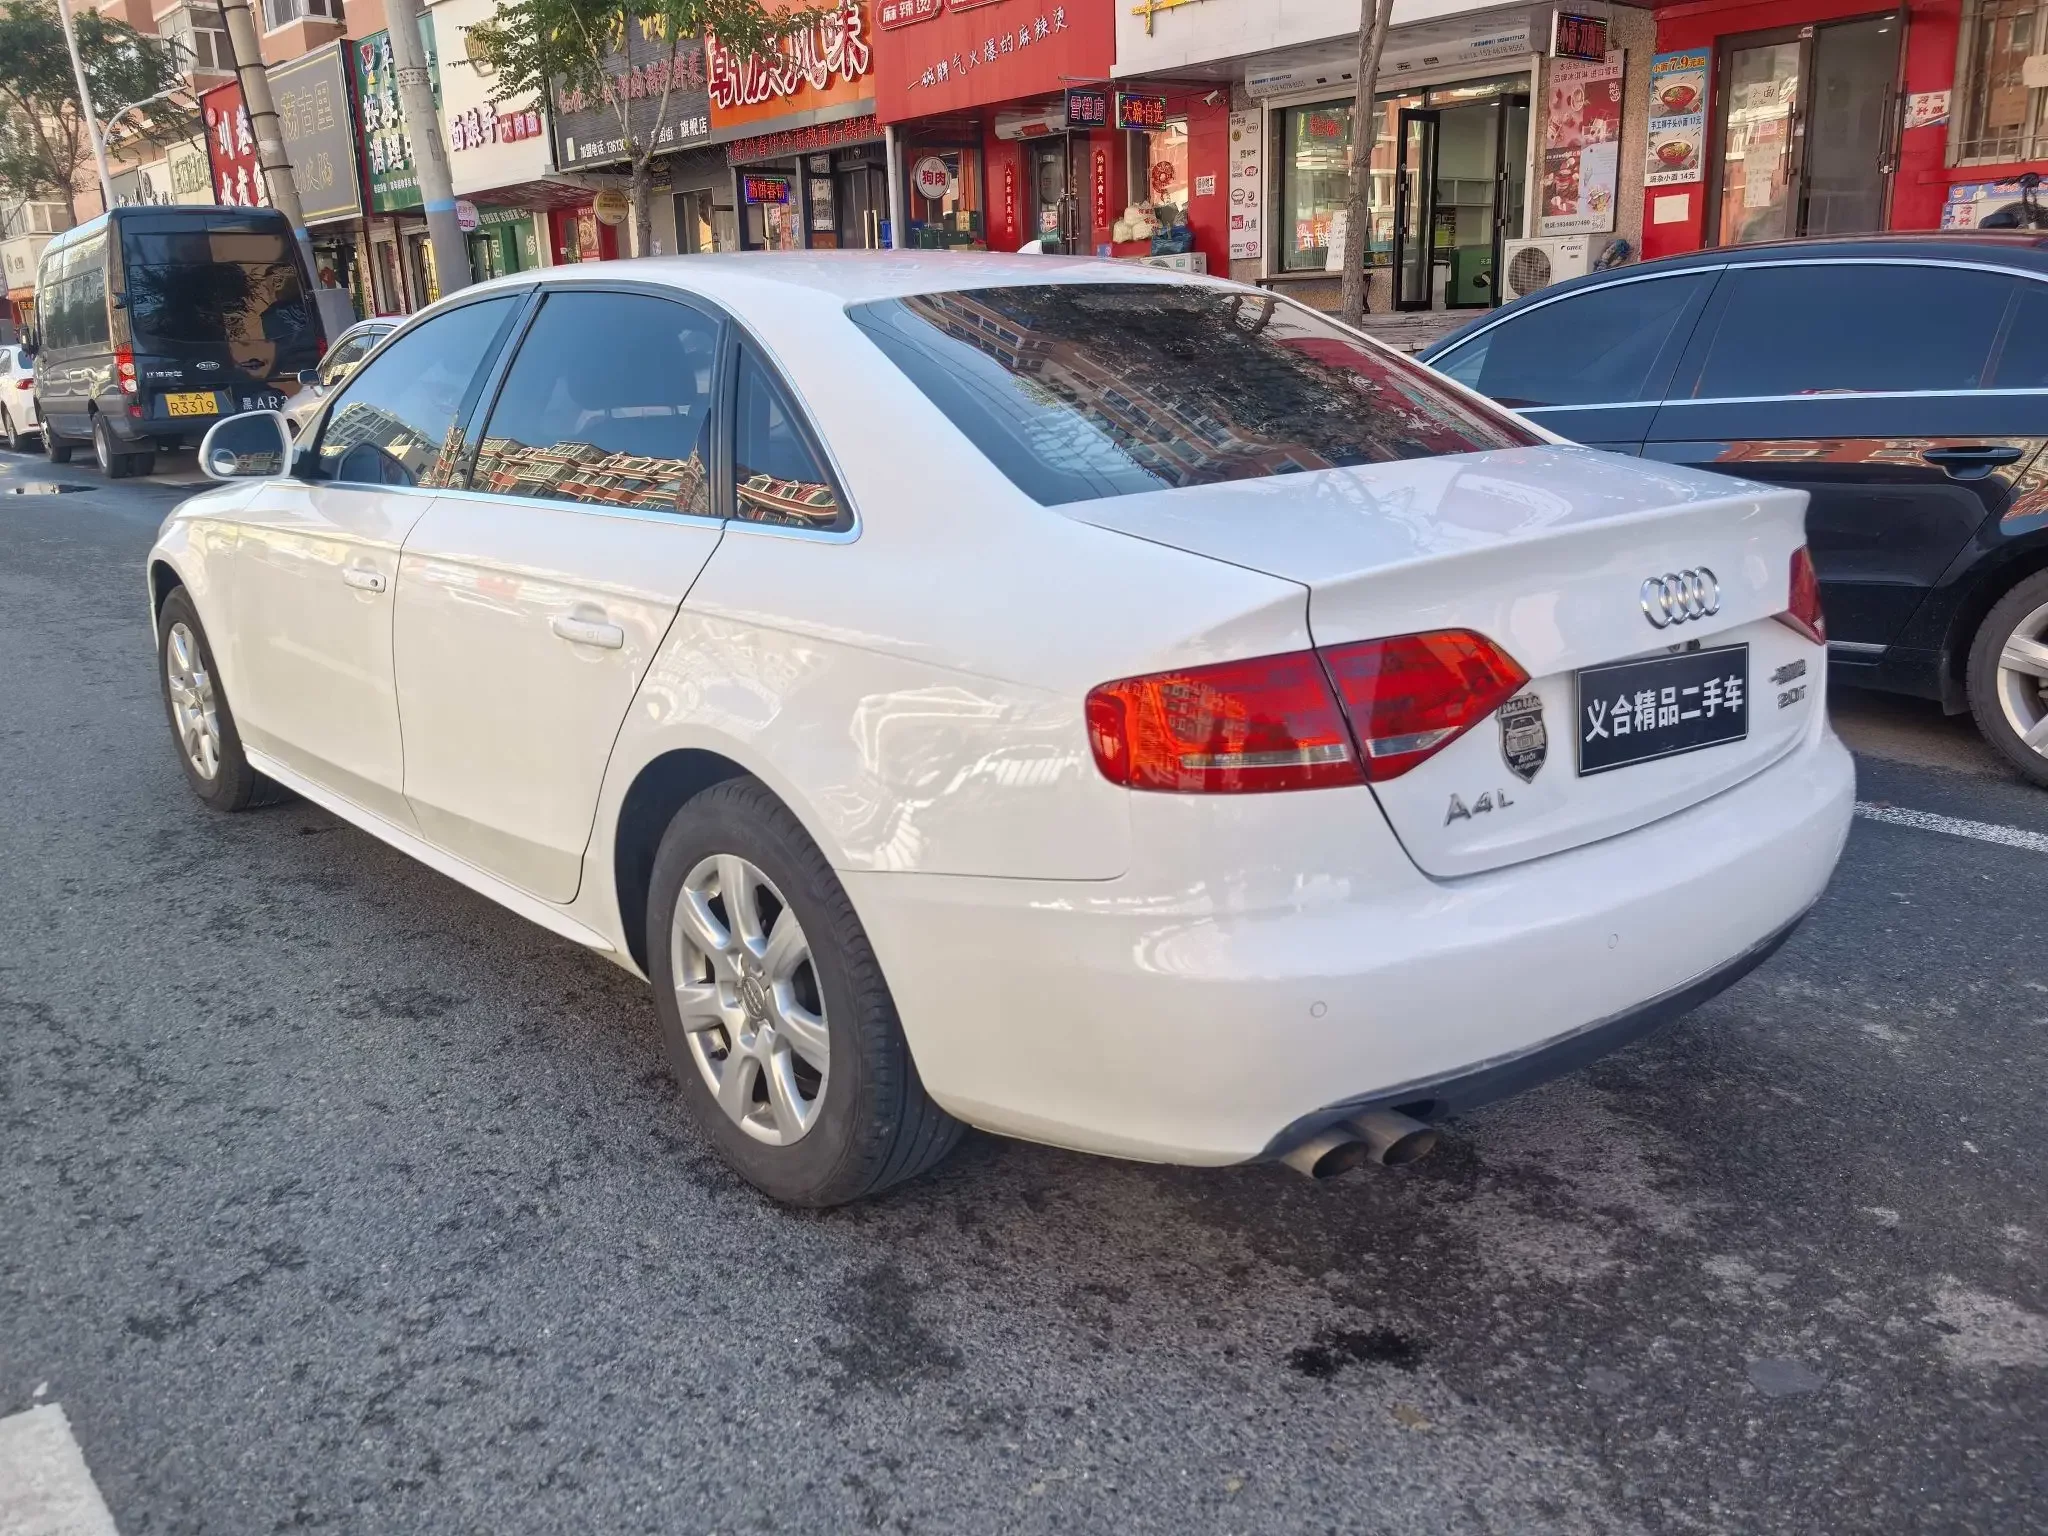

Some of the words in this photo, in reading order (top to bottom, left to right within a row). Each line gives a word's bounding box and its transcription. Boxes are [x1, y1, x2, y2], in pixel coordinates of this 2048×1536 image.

[883, 0, 931, 23] 麻辣烫
[907, 7, 1069, 90] 一碗脾气火爆的麻辣烫
[1071, 95, 1105, 121] 雪糕店
[680, 116, 708, 138] 旗舰店
[922, 170, 946, 186] 狗肉
[171, 400, 215, 415] R3319
[1585, 674, 1744, 743] 义合精品二手车
